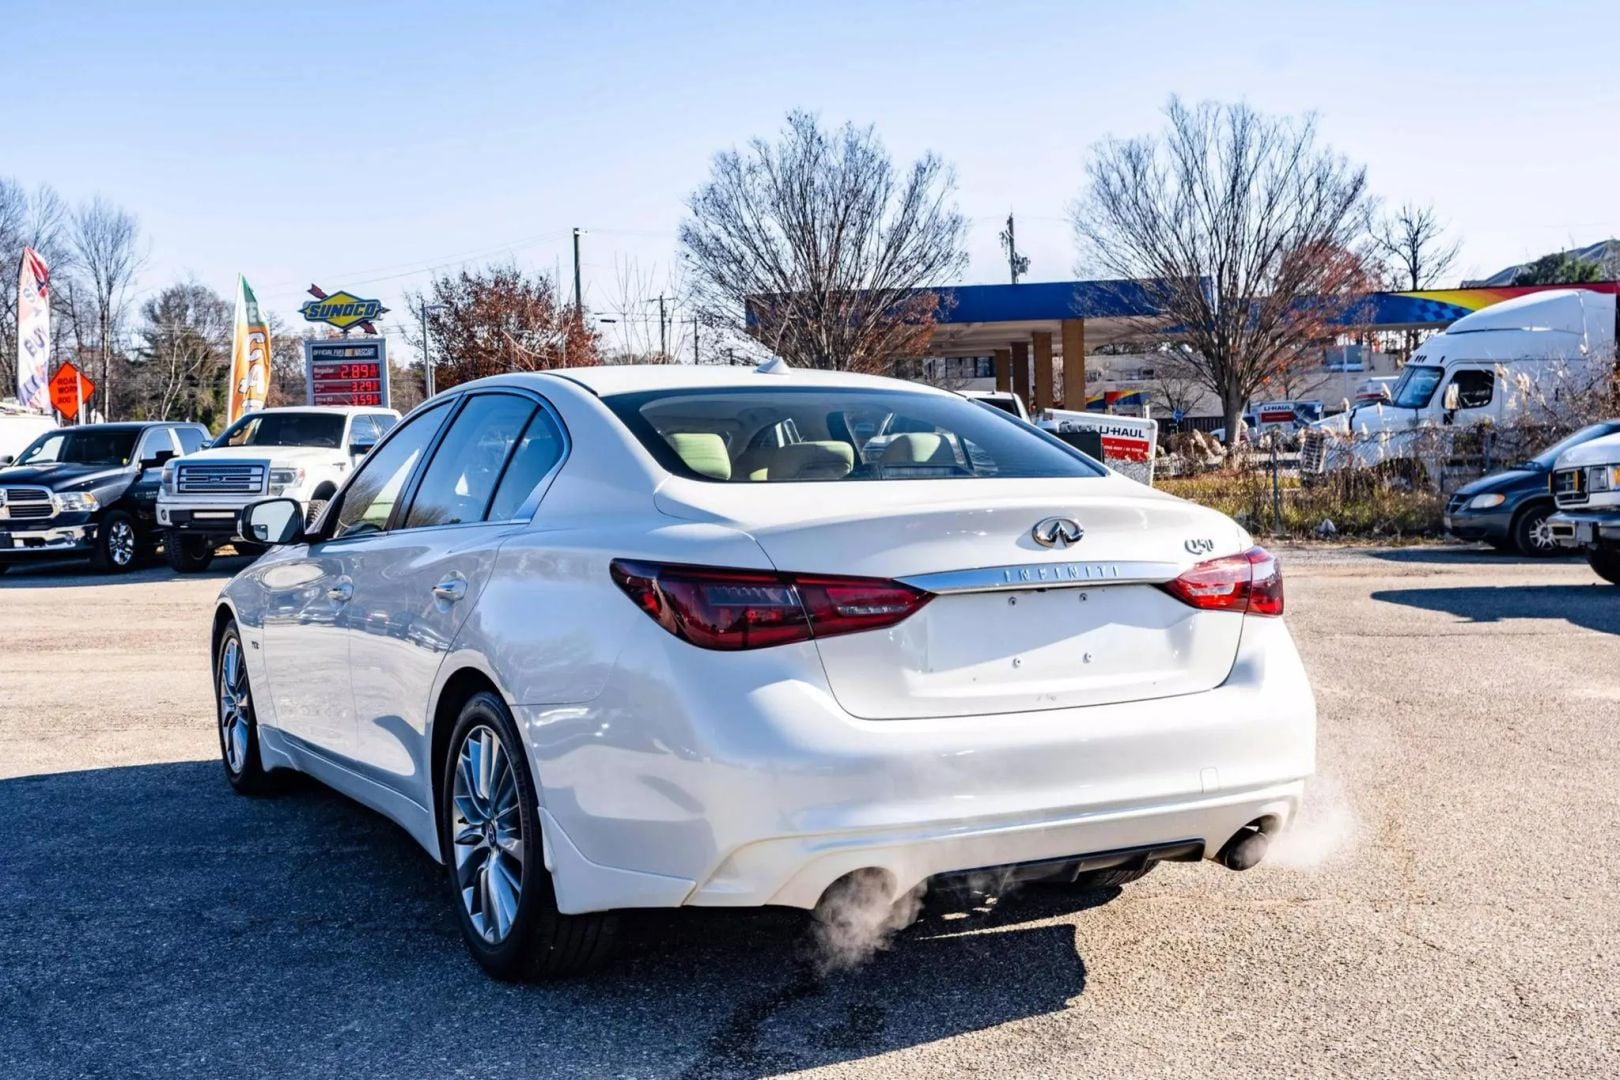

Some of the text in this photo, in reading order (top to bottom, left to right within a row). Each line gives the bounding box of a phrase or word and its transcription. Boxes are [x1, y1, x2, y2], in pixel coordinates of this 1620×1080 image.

[308, 303, 376, 317] SUNOCO
[340, 365, 369, 378] 2.89
[1099, 425, 1145, 438] U-HAUL
[1184, 538, 1214, 556] Q50
[1003, 563, 1119, 582] INFINITI
